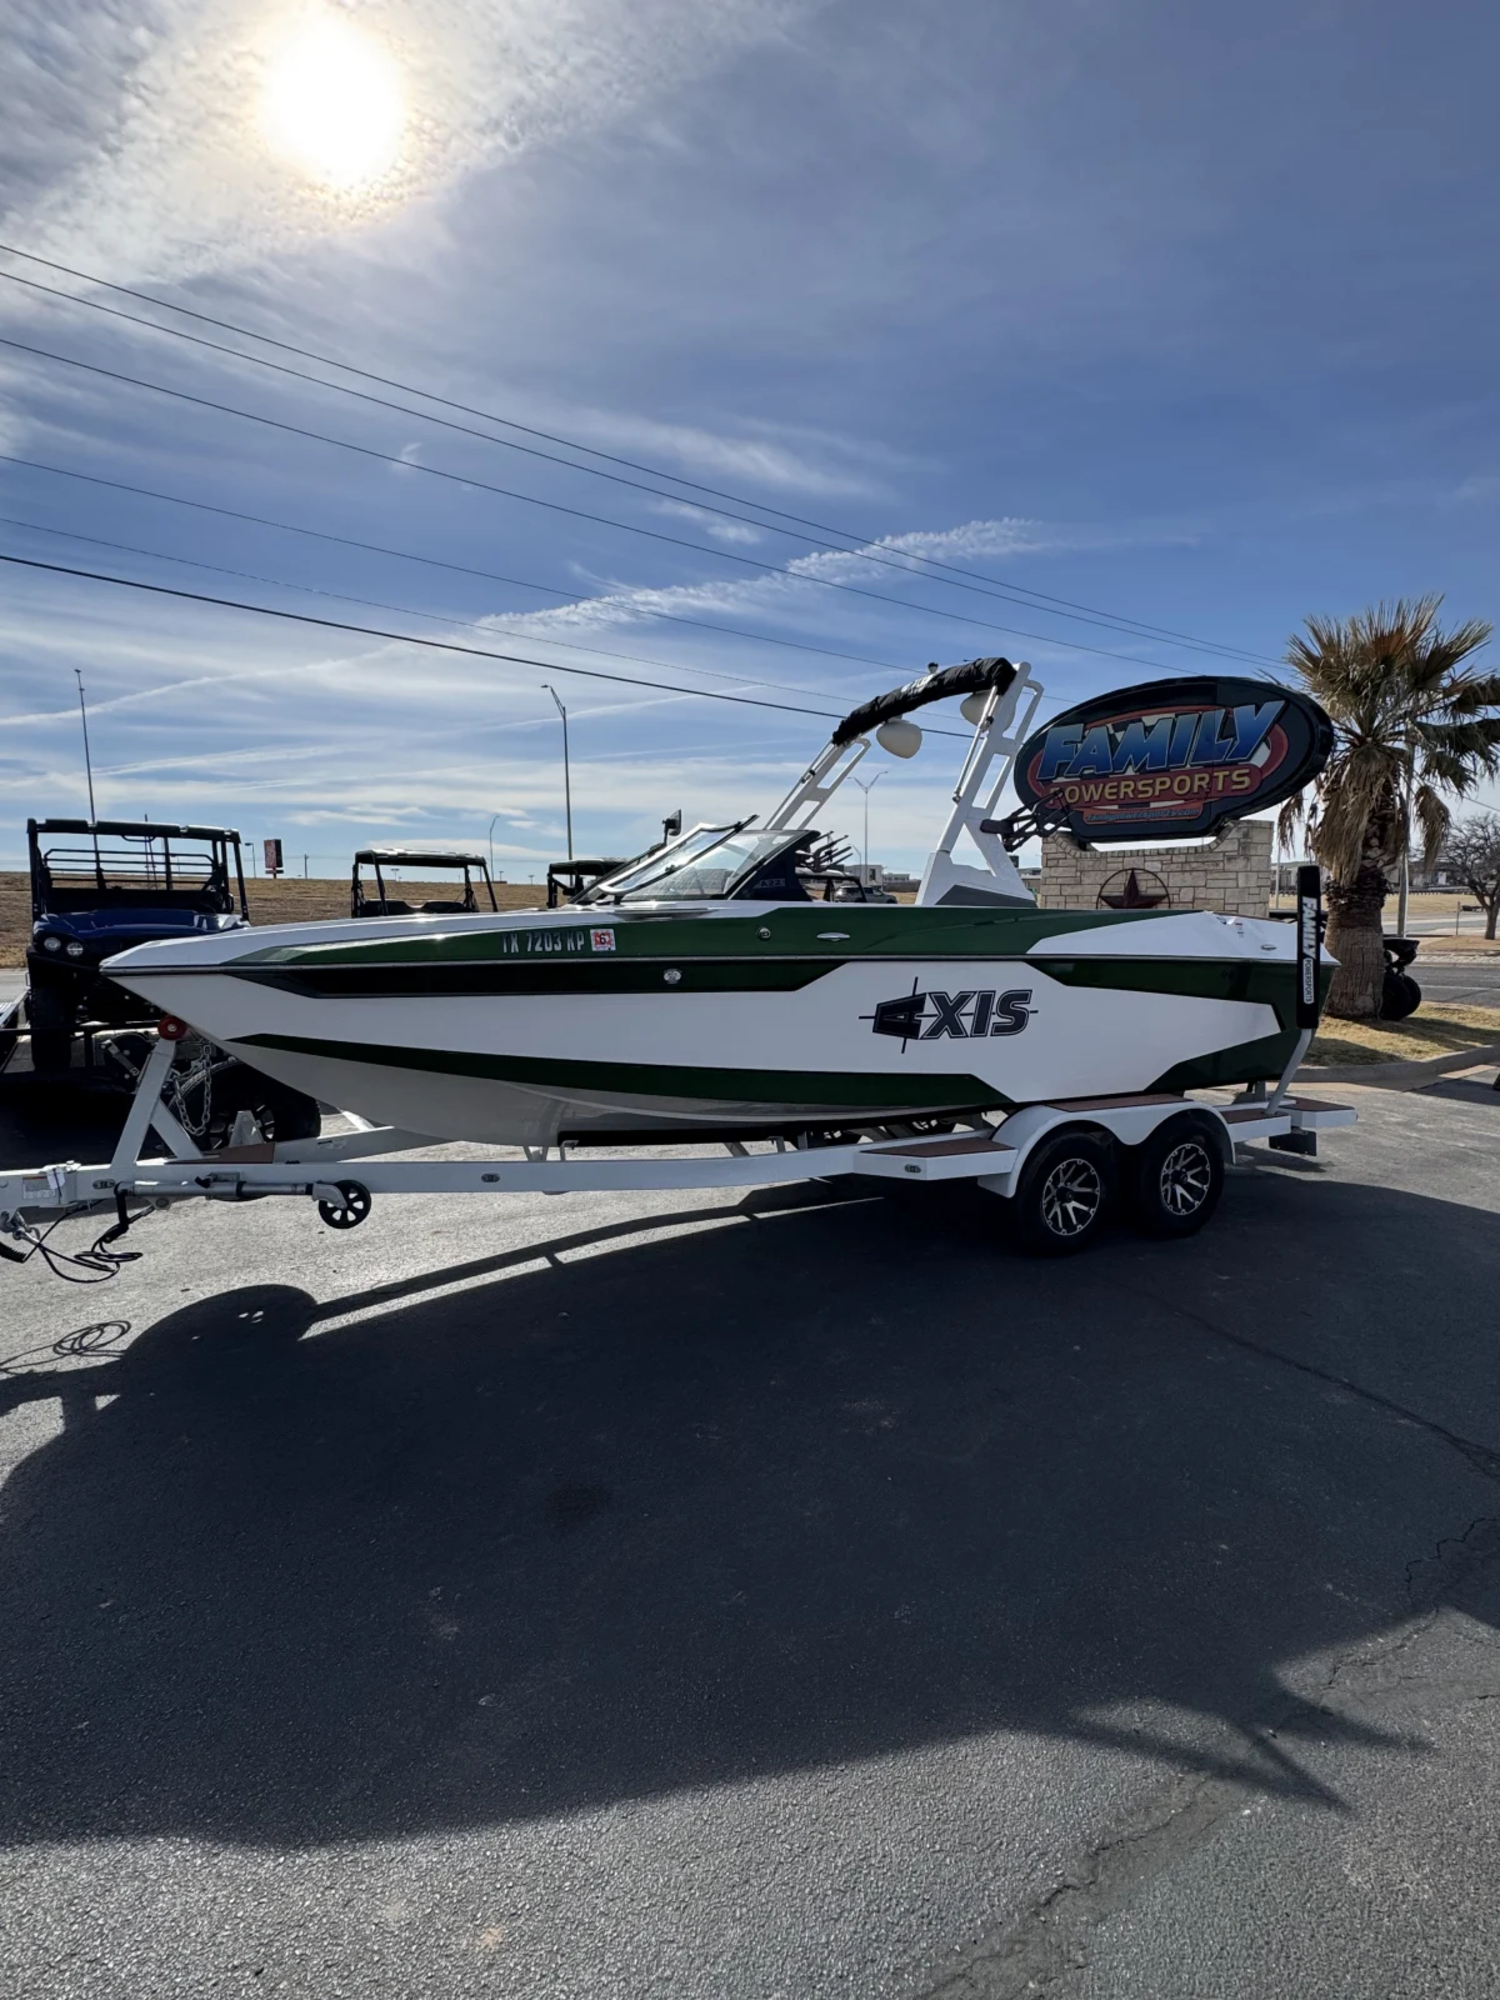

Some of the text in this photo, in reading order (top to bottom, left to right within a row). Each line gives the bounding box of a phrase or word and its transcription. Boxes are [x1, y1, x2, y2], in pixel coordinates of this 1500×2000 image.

[1037, 700, 1286, 780] FAMILY
[502, 933, 519, 953] TX
[526, 931, 562, 952] 7203
[1302, 896, 1317, 1002] FAMILY POWERSPORTS
[872, 989, 1032, 1040] AXIS
